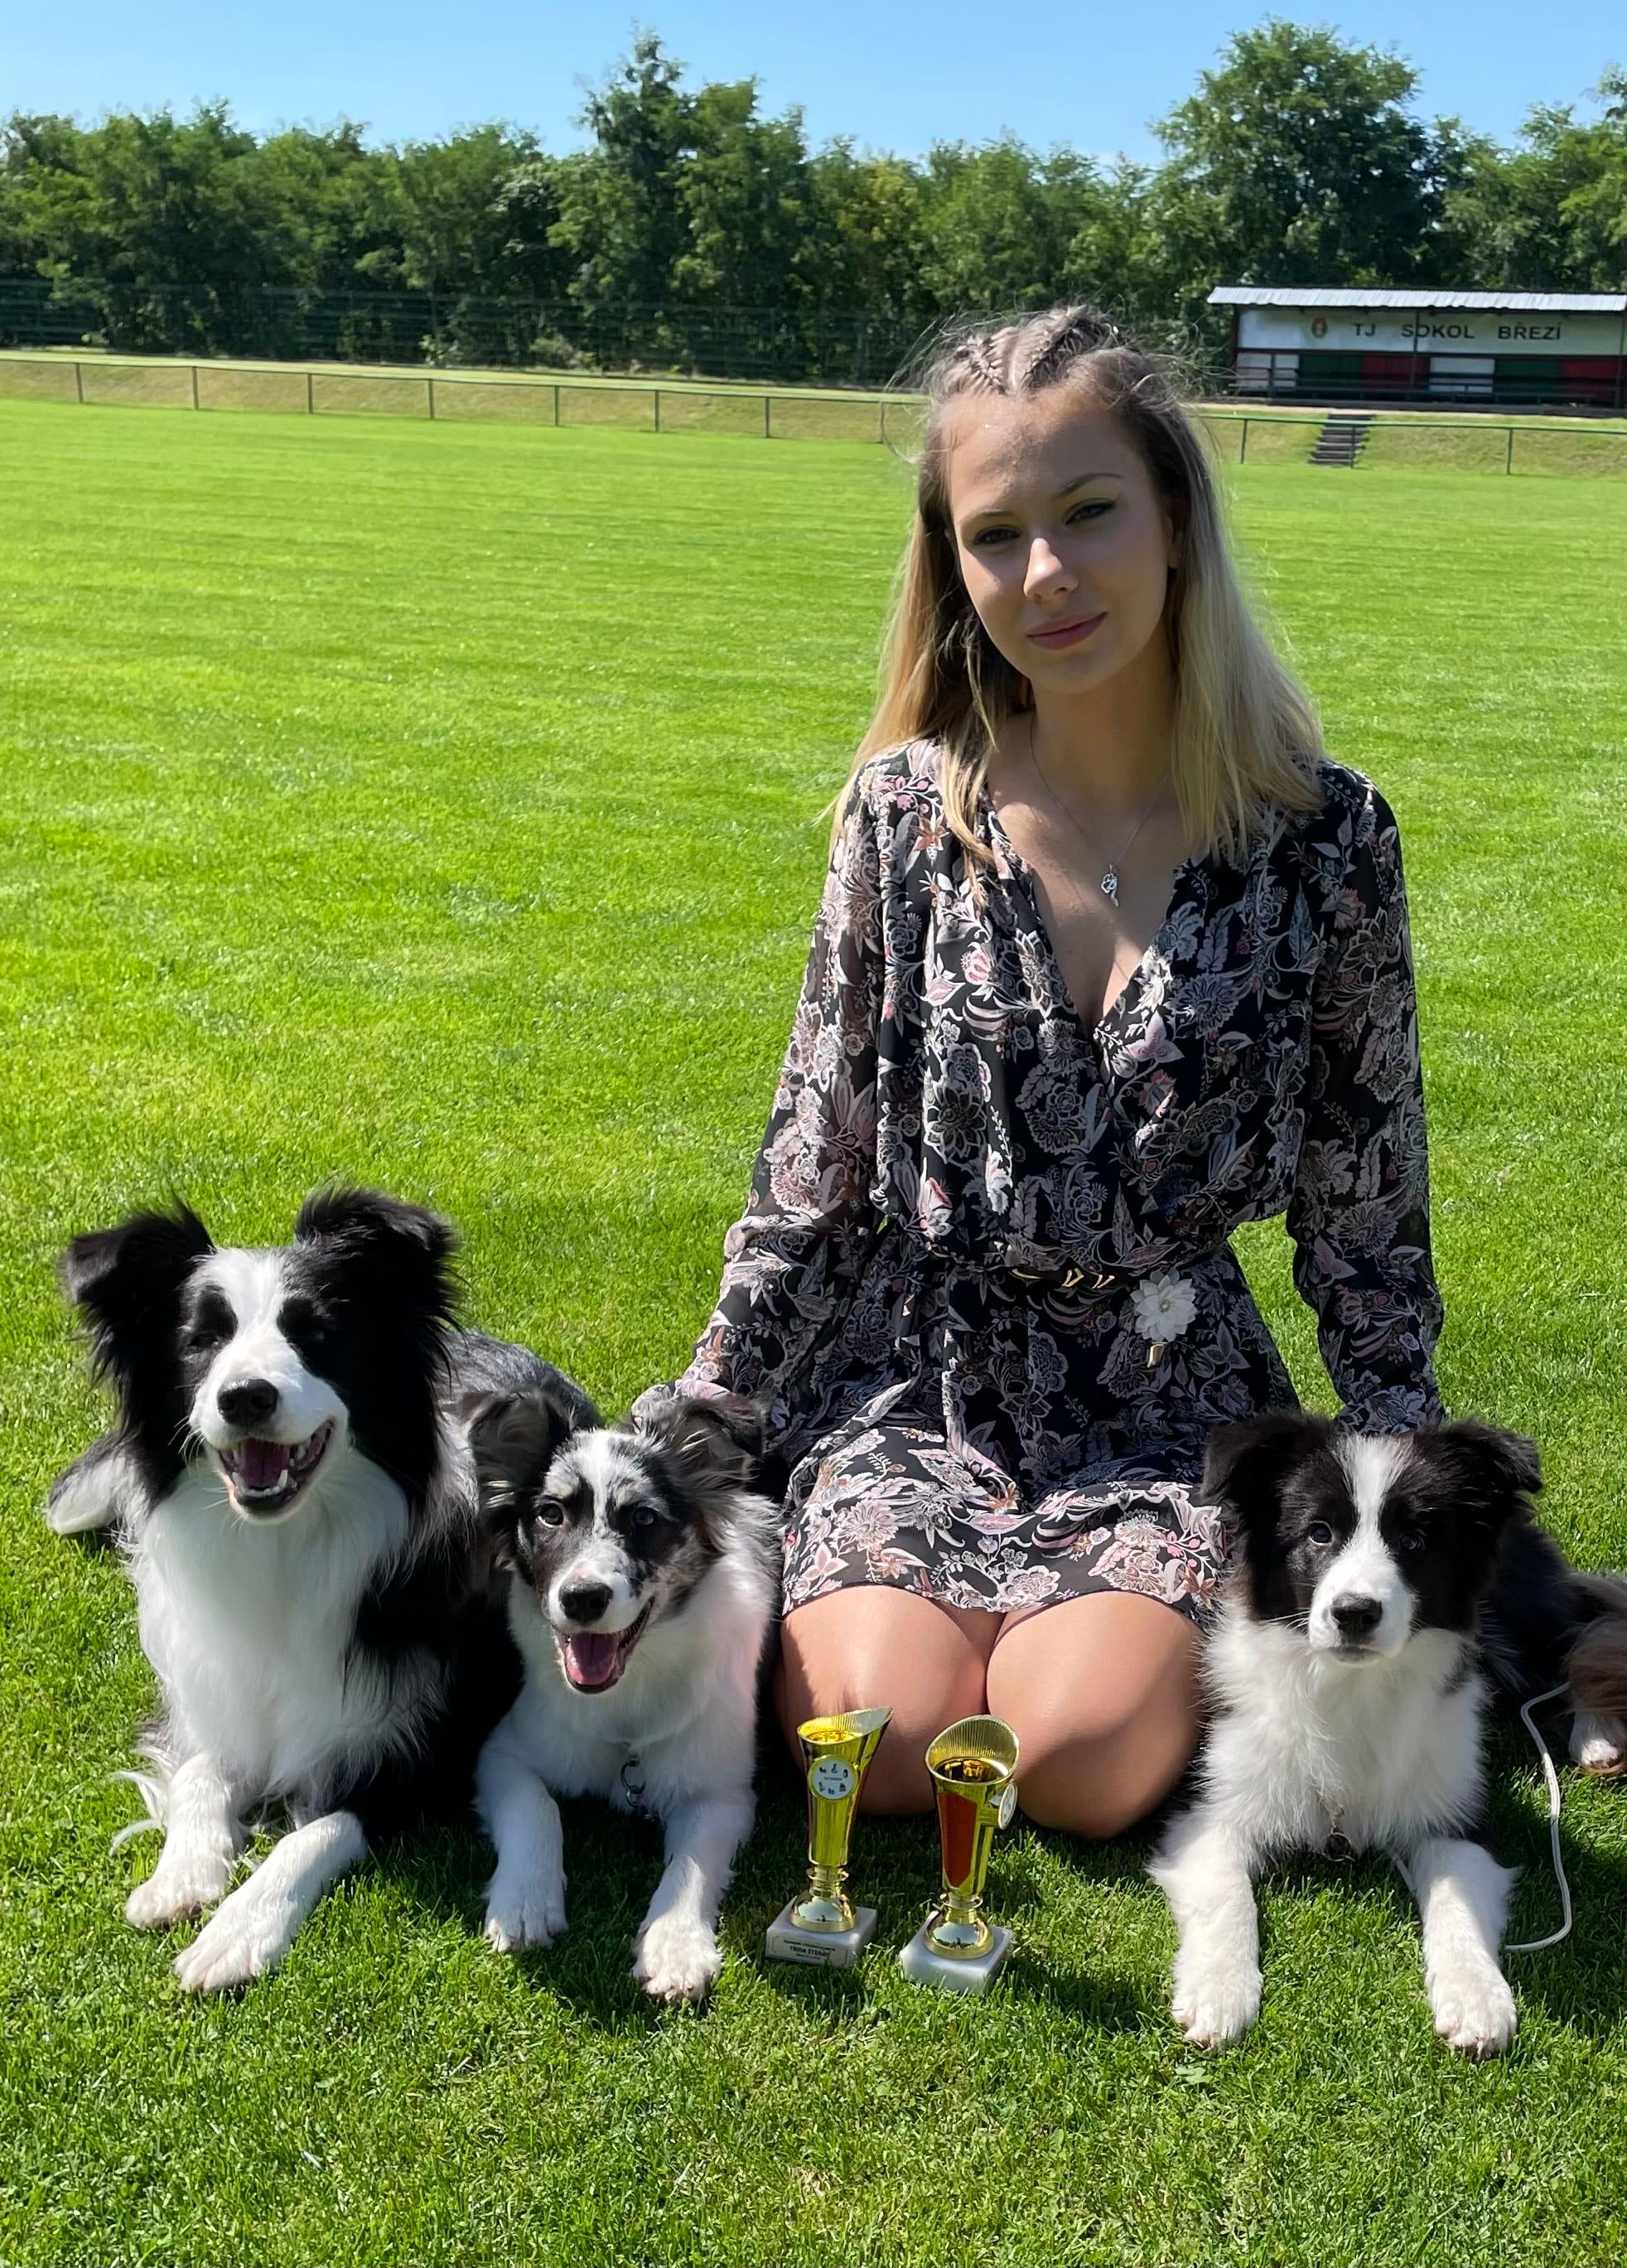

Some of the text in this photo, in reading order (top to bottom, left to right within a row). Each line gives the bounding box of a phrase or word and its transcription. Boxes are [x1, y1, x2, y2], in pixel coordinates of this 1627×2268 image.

[1353, 322, 1562, 340] TJ SOKOL BŘEZÍ
